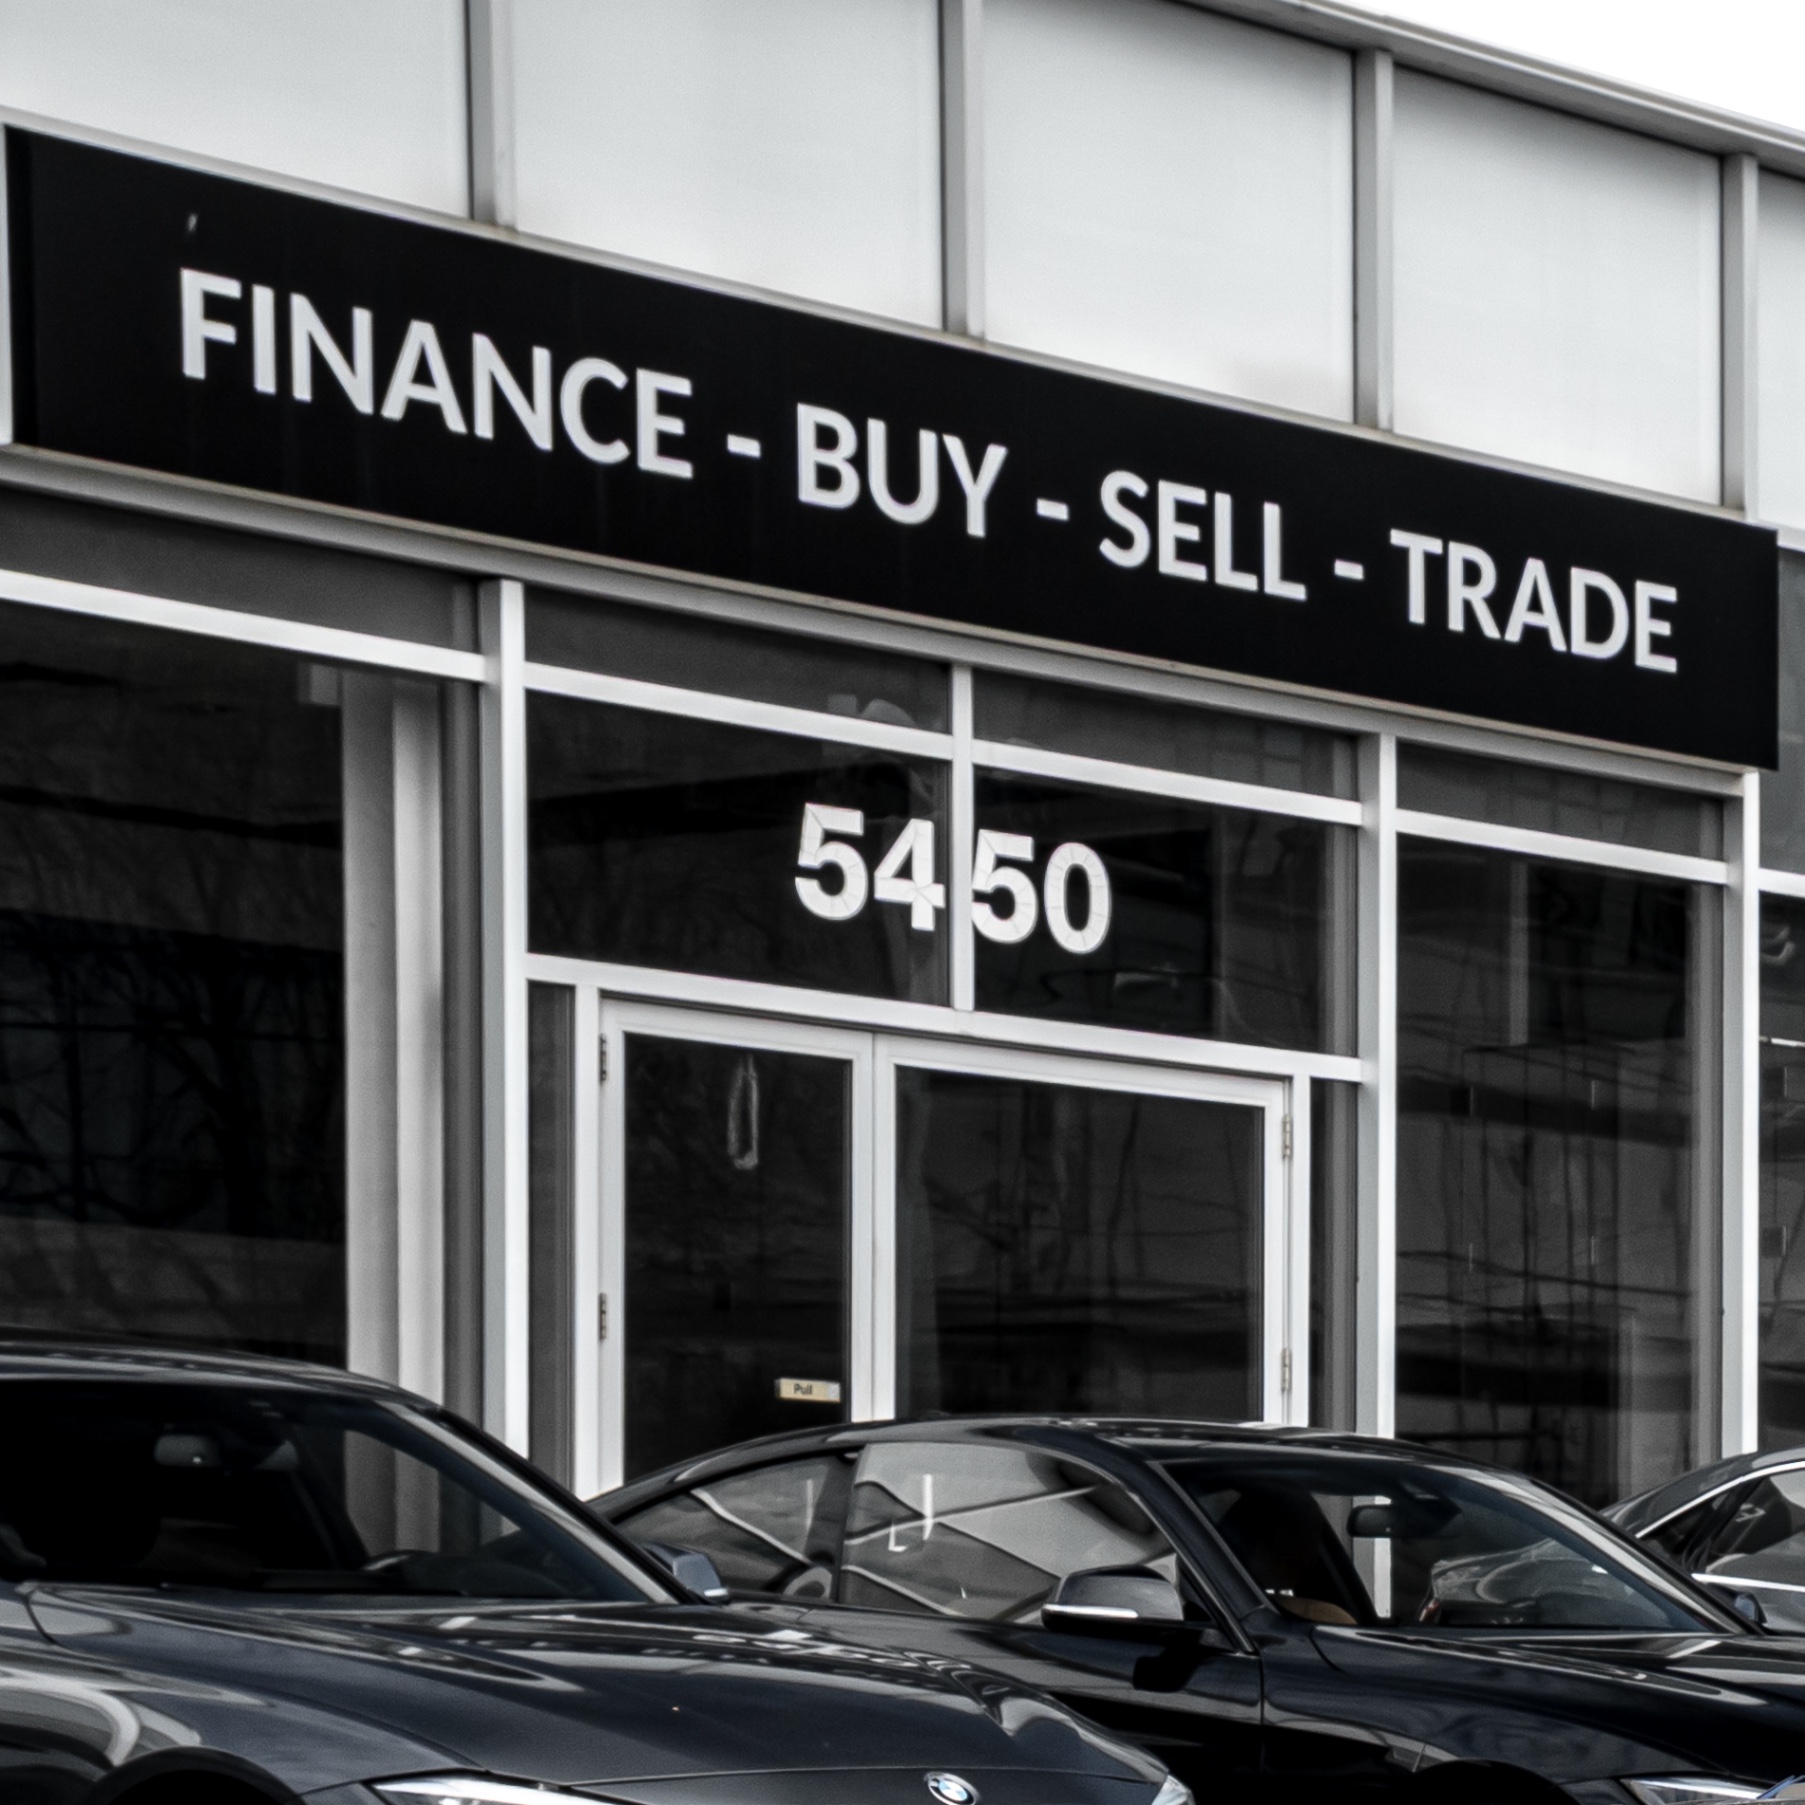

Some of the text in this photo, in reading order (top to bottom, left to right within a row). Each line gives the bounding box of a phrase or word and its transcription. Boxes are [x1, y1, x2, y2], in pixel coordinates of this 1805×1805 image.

[180, 267, 693, 479] FINANCE
[797, 402, 1007, 538] BUY
[1099, 469, 1307, 600] SELL
[1390, 528, 1678, 673] TRADE
[795, 802, 1112, 954] 5450
[793, 1383, 813, 1396] Pull
